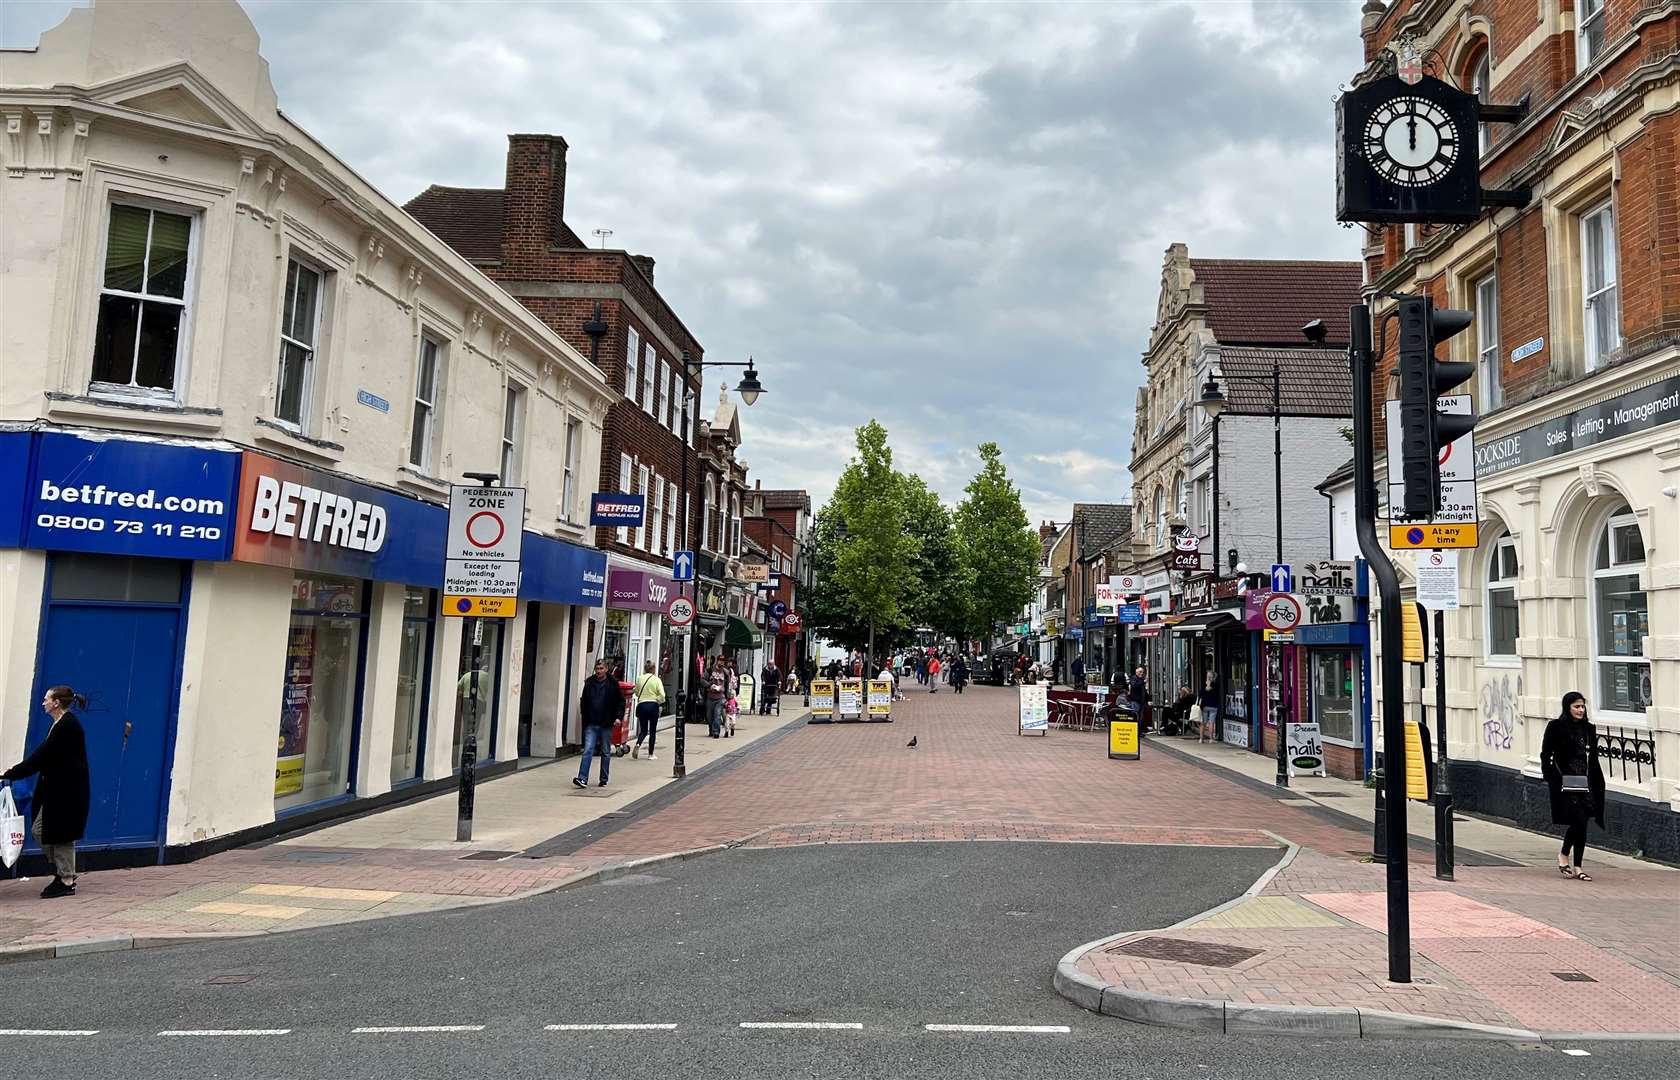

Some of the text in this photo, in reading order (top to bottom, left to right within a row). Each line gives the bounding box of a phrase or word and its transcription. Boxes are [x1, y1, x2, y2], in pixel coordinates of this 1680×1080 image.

[1546, 390, 1680, 446] Sales Letting Management
[40, 480, 224, 515] betfred.com
[463, 489, 514, 497] PEDESTRIAN
[469, 498, 505, 508] ZONE
[597, 503, 640, 513] BETFRED
[251, 475, 387, 553] BETFRED
[1435, 512, 1472, 521] Midnight
[37, 514, 221, 540] 0800 73 11 210
[1432, 527, 1460, 536] At any
[1175, 554, 1199, 565] Cafe
[464, 562, 489, 570] Except
[1319, 561, 1351, 571] Dream
[446, 578, 478, 586] Midnight
[1301, 571, 1353, 588] nails
[613, 590, 639, 599] Scope
[648, 578, 667, 608] Scope
[1097, 588, 1112, 599] FOR
[1310, 596, 1341, 624] nails
[1294, 724, 1318, 733] Dream
[1287, 737, 1323, 755] nails
